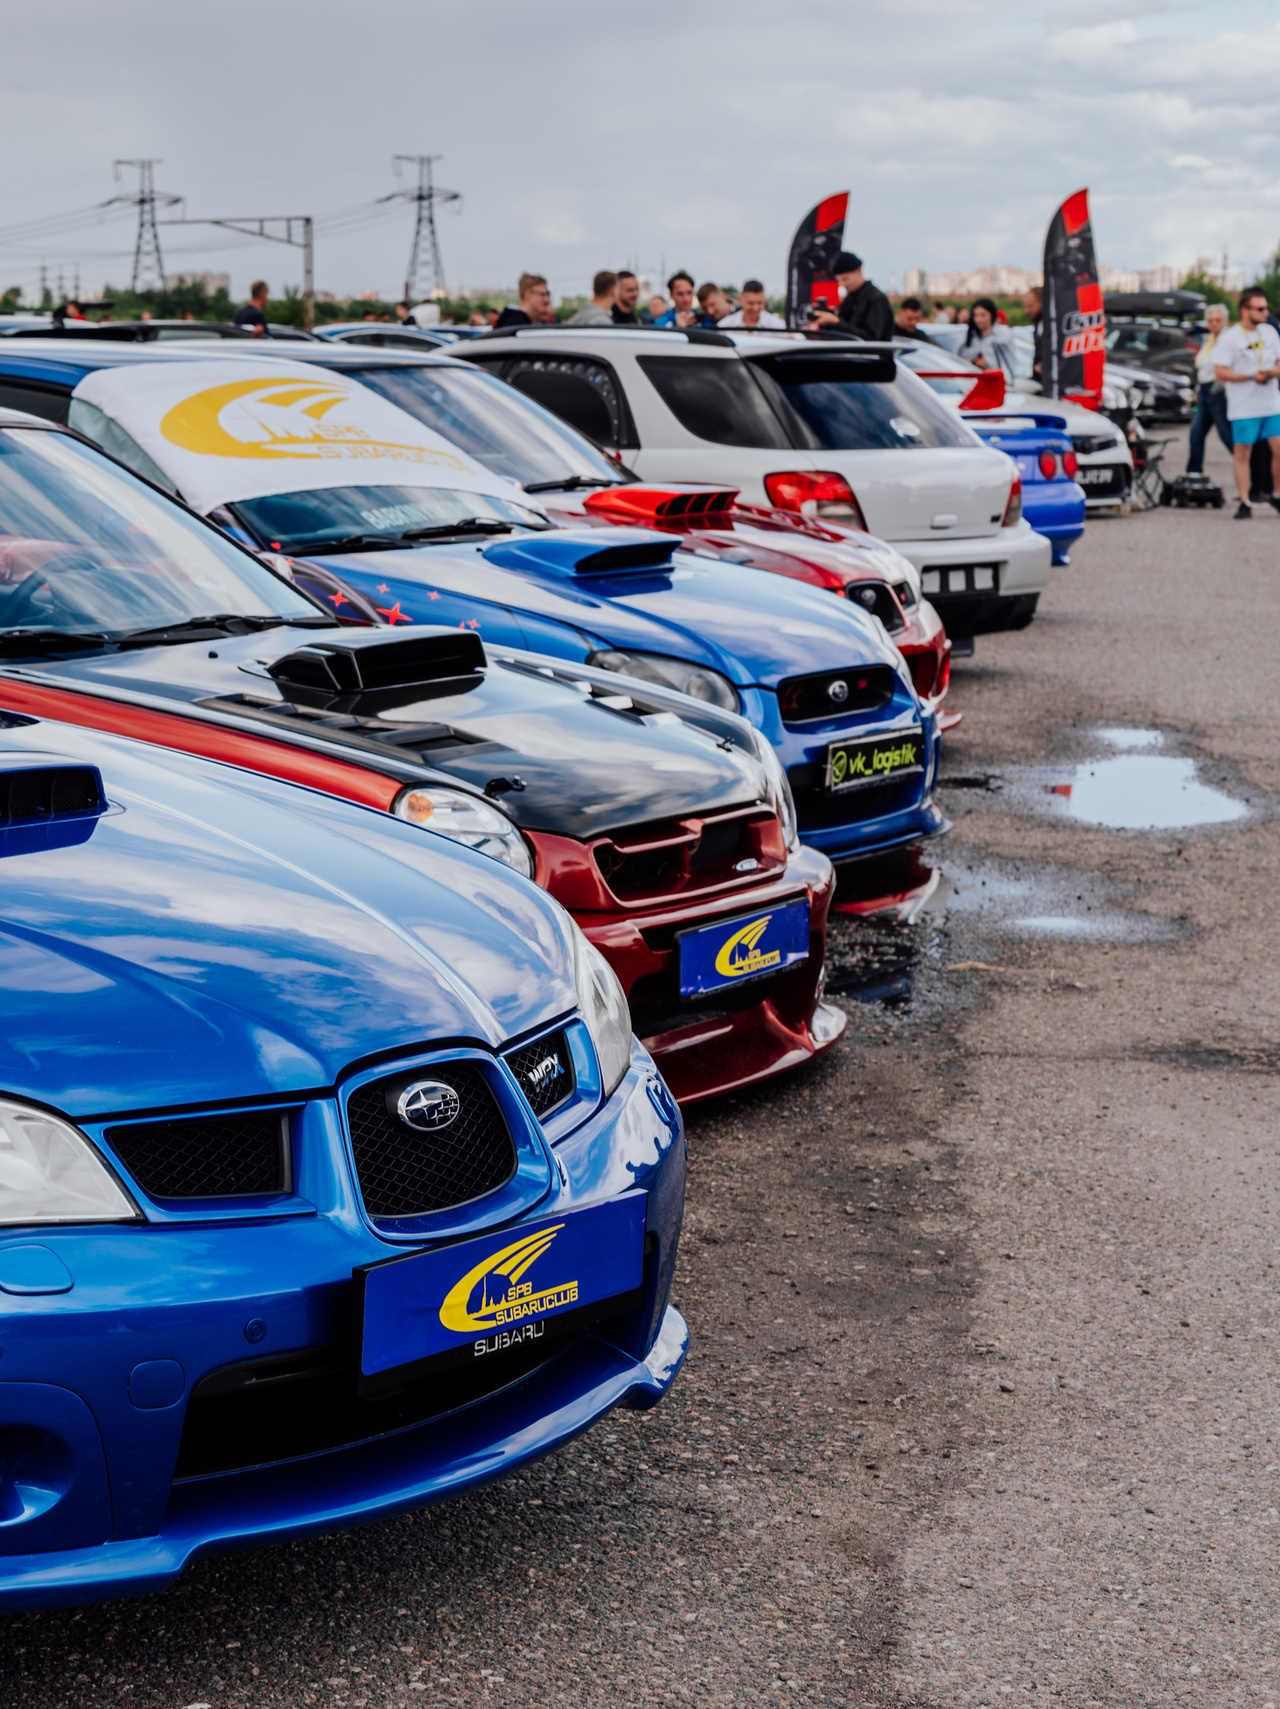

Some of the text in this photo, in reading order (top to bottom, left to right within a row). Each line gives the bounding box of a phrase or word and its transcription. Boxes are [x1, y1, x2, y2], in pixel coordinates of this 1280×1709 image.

[848, 742, 917, 776] vk_logistik
[528, 1053, 565, 1093] WRX
[495, 1288, 578, 1325] SUBARUCLUB
[507, 1281, 532, 1301] SPB
[474, 1320, 545, 1357] SUBARU
